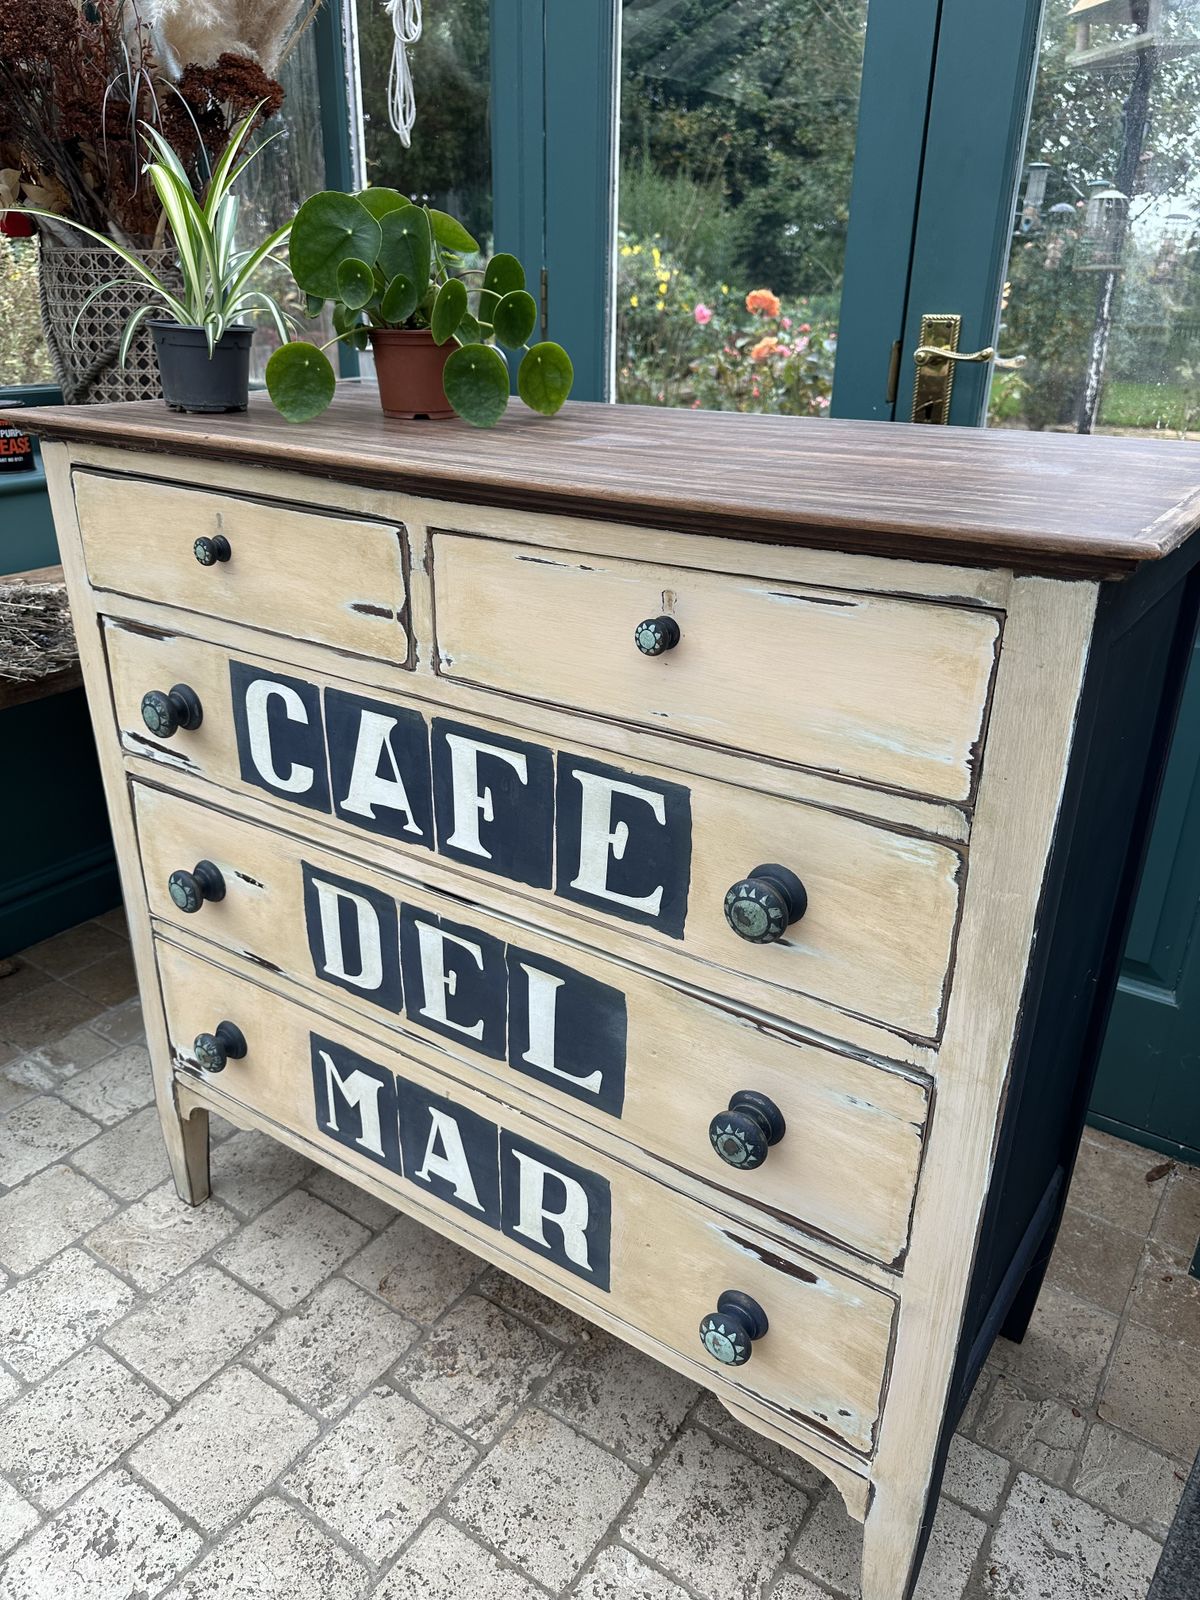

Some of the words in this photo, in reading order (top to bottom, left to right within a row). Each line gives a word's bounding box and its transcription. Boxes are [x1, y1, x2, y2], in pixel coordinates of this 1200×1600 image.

[245, 679, 667, 917] CAFE
[312, 877, 603, 1095] DEL
[318, 1050, 594, 1272] MAR
